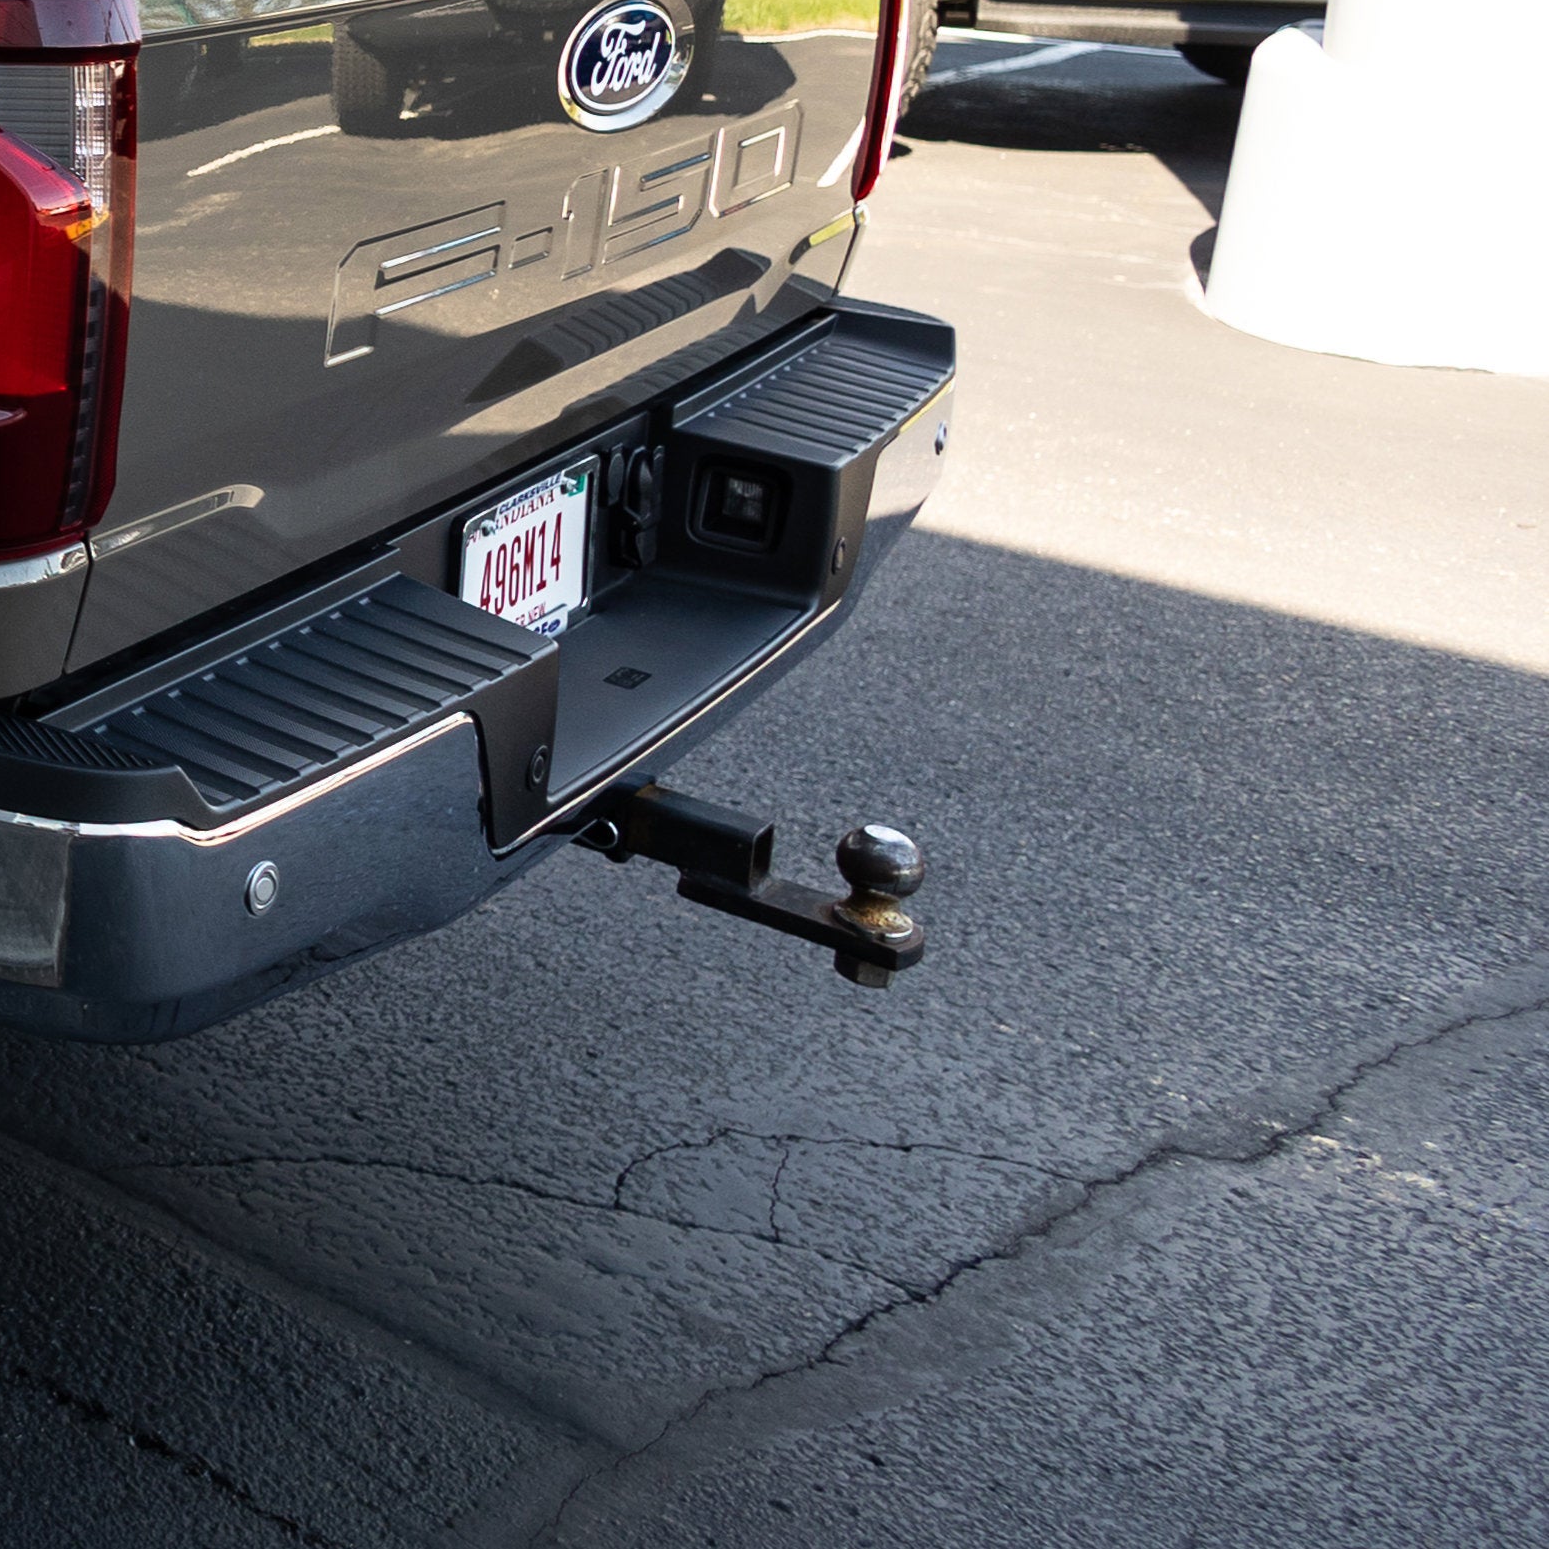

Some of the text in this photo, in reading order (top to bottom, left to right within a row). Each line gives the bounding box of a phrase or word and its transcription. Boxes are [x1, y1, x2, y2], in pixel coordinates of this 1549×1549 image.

[590, 19, 661, 97] Ford
[323, 97, 802, 368] F-150
[498, 471, 562, 515] CLARKSVILLE
[480, 511, 563, 616] 496M14
